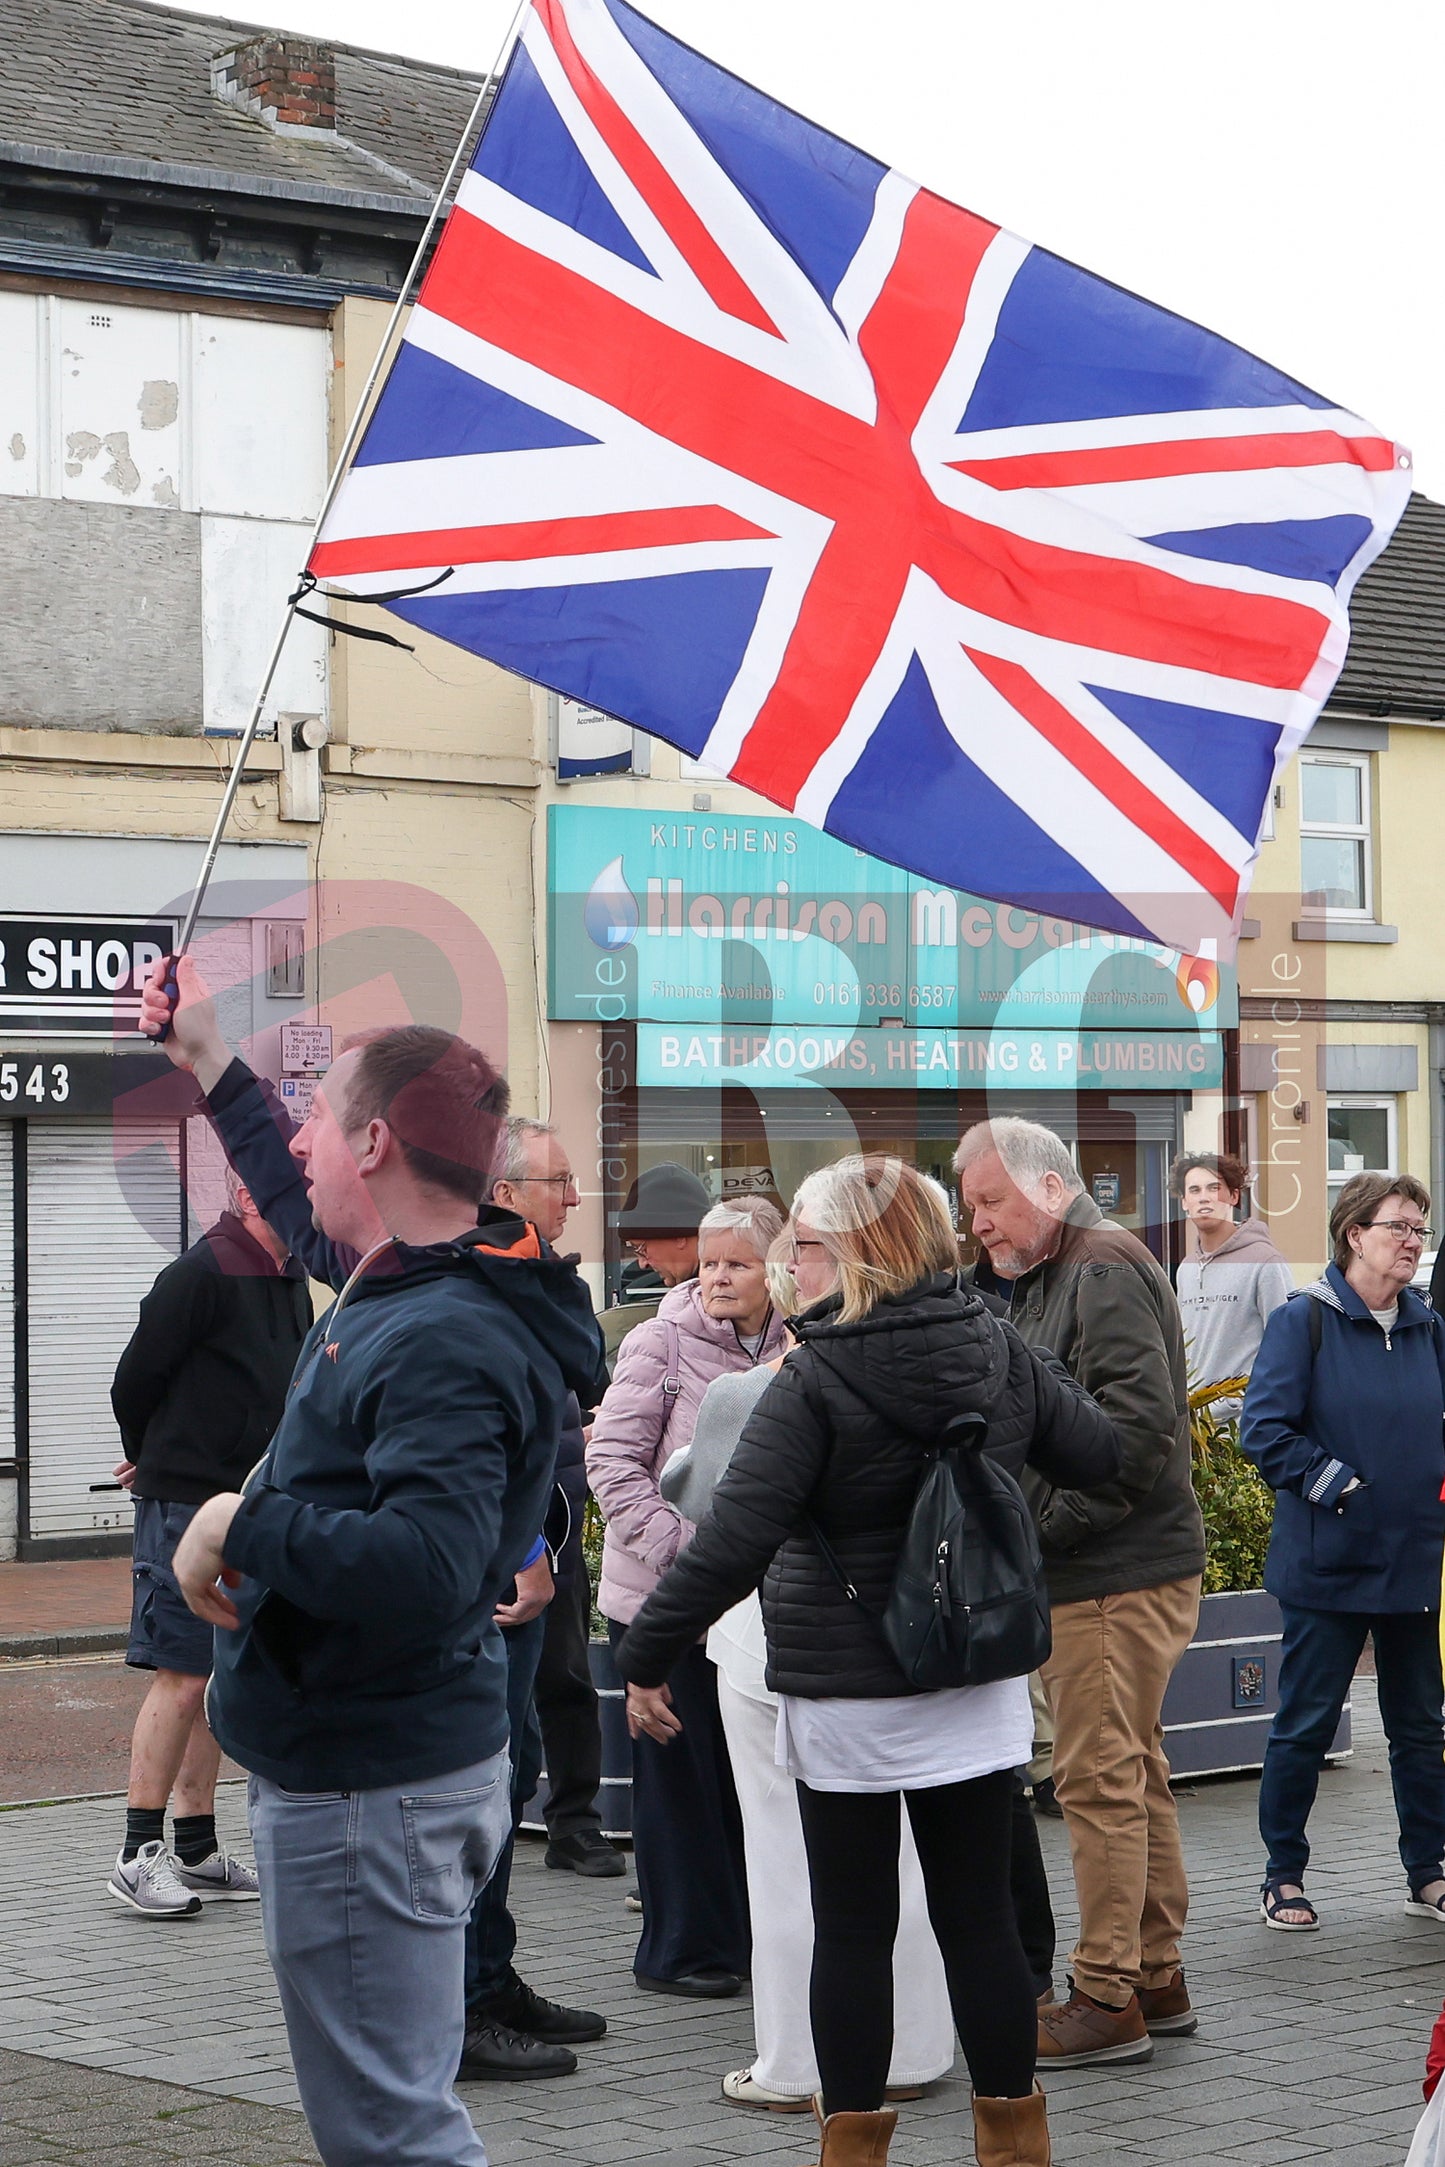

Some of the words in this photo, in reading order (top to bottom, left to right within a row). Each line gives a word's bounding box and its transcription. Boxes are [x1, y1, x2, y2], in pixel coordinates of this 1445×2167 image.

[650, 823, 798, 854] KITCHENS
[647, 877, 887, 945] Harrison
[27, 937, 163, 990] SHOP
[651, 981, 712, 999] Finance
[717, 983, 785, 1001] Available
[813, 982, 860, 1006] 0161
[865, 983, 902, 1007] 336
[909, 985, 956, 1008] 6587
[978, 988, 1169, 1008] www.harrisonmccarthys.com
[660, 1036, 877, 1075] BATHROOMS,
[887, 1039, 1020, 1072] HEATING
[1027, 1042, 1048, 1072] &
[1056, 1042, 1207, 1073] PLUMBING
[0, 1063, 70, 1102] 543
[285, 1083, 294, 1095] P
[723, 1177, 775, 1188] DEVA
